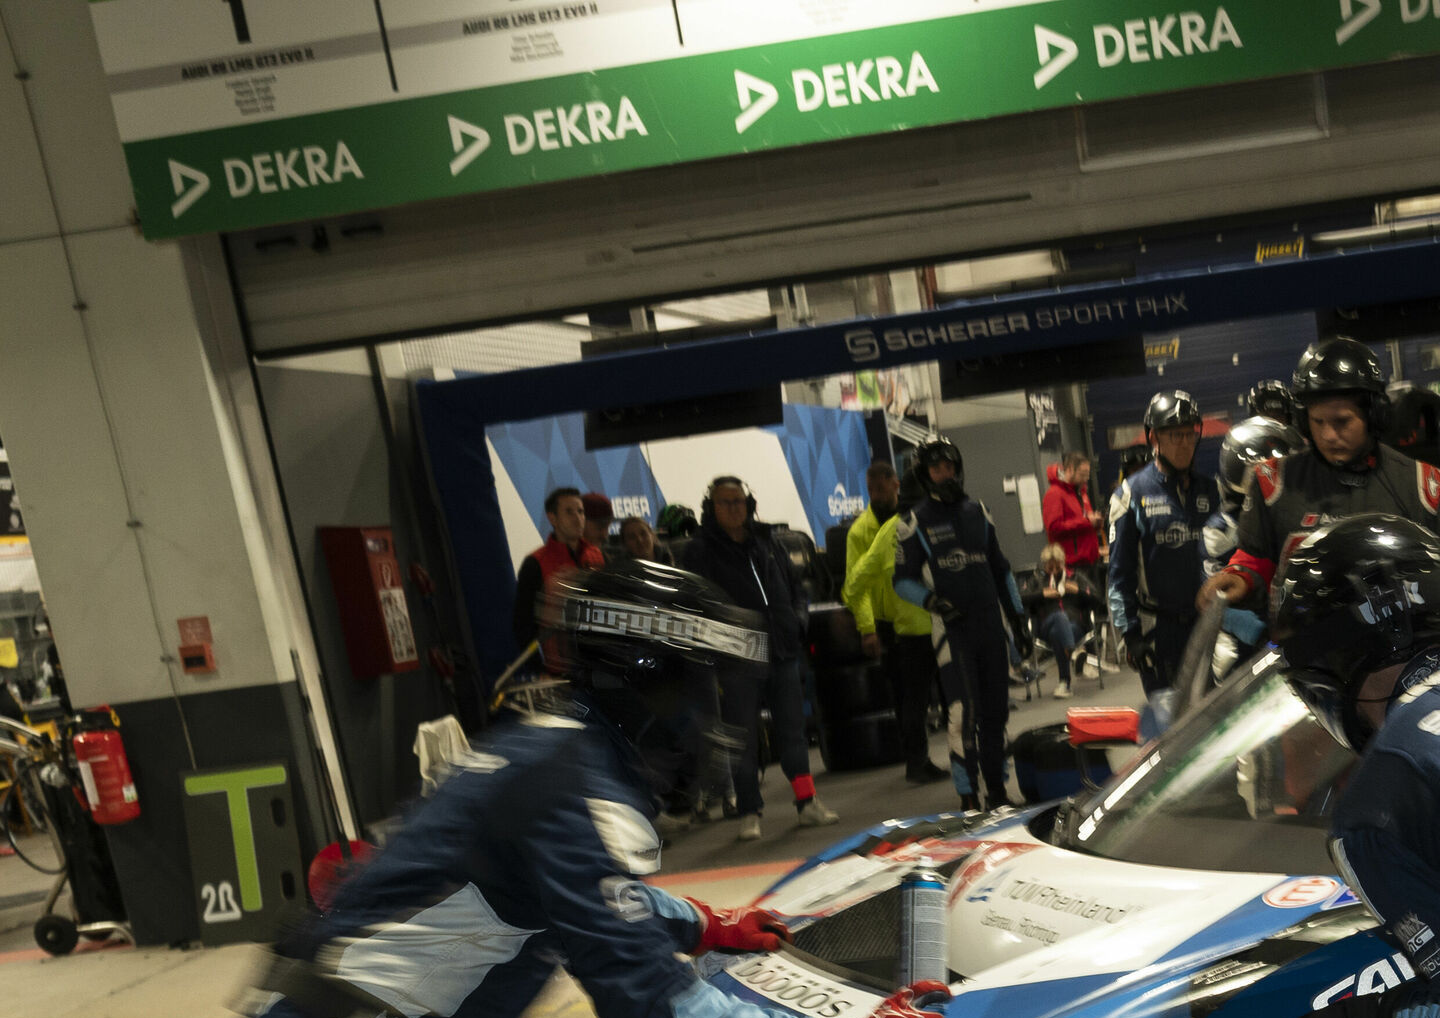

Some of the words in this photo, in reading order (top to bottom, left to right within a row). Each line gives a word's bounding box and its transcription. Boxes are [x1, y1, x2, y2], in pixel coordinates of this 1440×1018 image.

[1093, 6, 1244, 69] DEKRA
[792, 50, 941, 113] DEKRA
[504, 95, 650, 156] DEKRA
[223, 139, 365, 198] DEKRA
[883, 312, 1030, 352] SCHERER
[1035, 299, 1130, 330] SPORT
[1135, 291, 1190, 319] PHX
